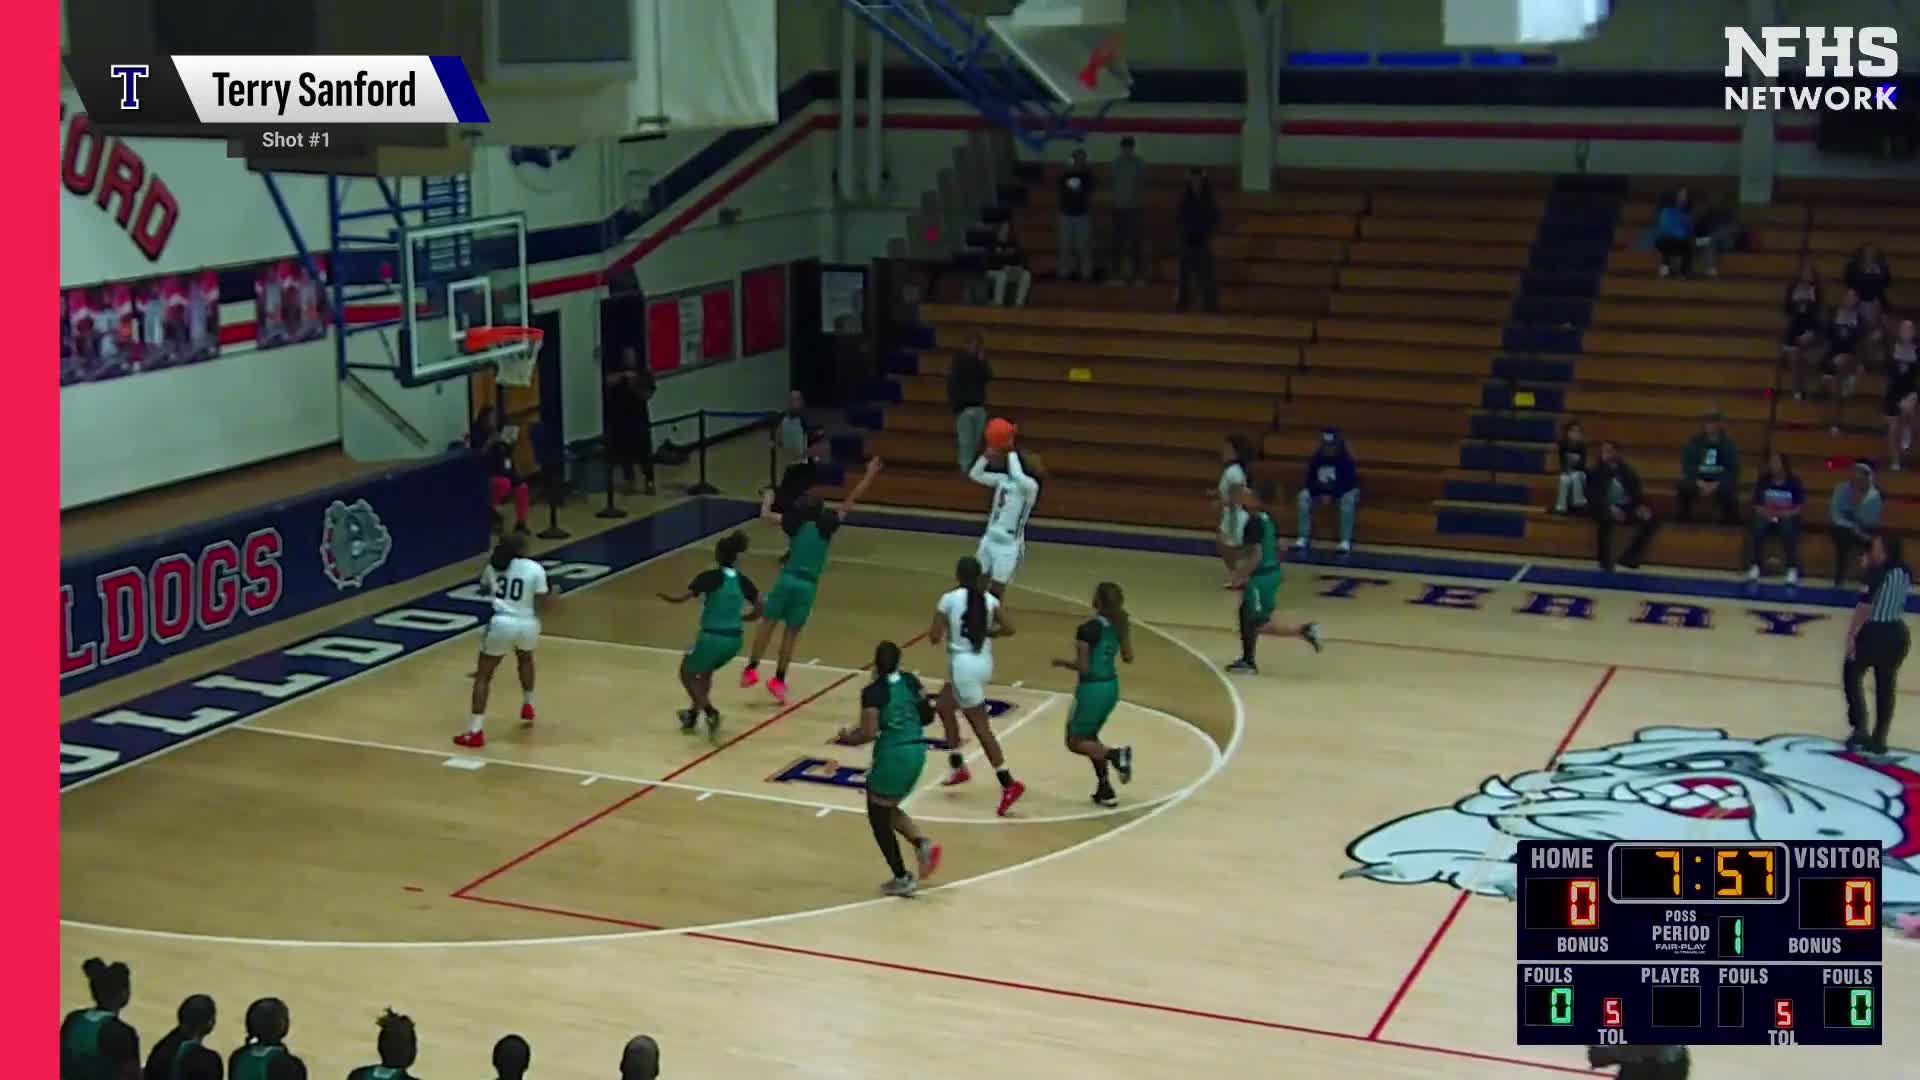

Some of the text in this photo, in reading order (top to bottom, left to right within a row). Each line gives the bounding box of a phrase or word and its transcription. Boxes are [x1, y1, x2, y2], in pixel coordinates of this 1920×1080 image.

[60, 103, 180, 263] ORD
[495, 577, 523, 601] 30
[1317, 575, 1829, 637] TERRY
